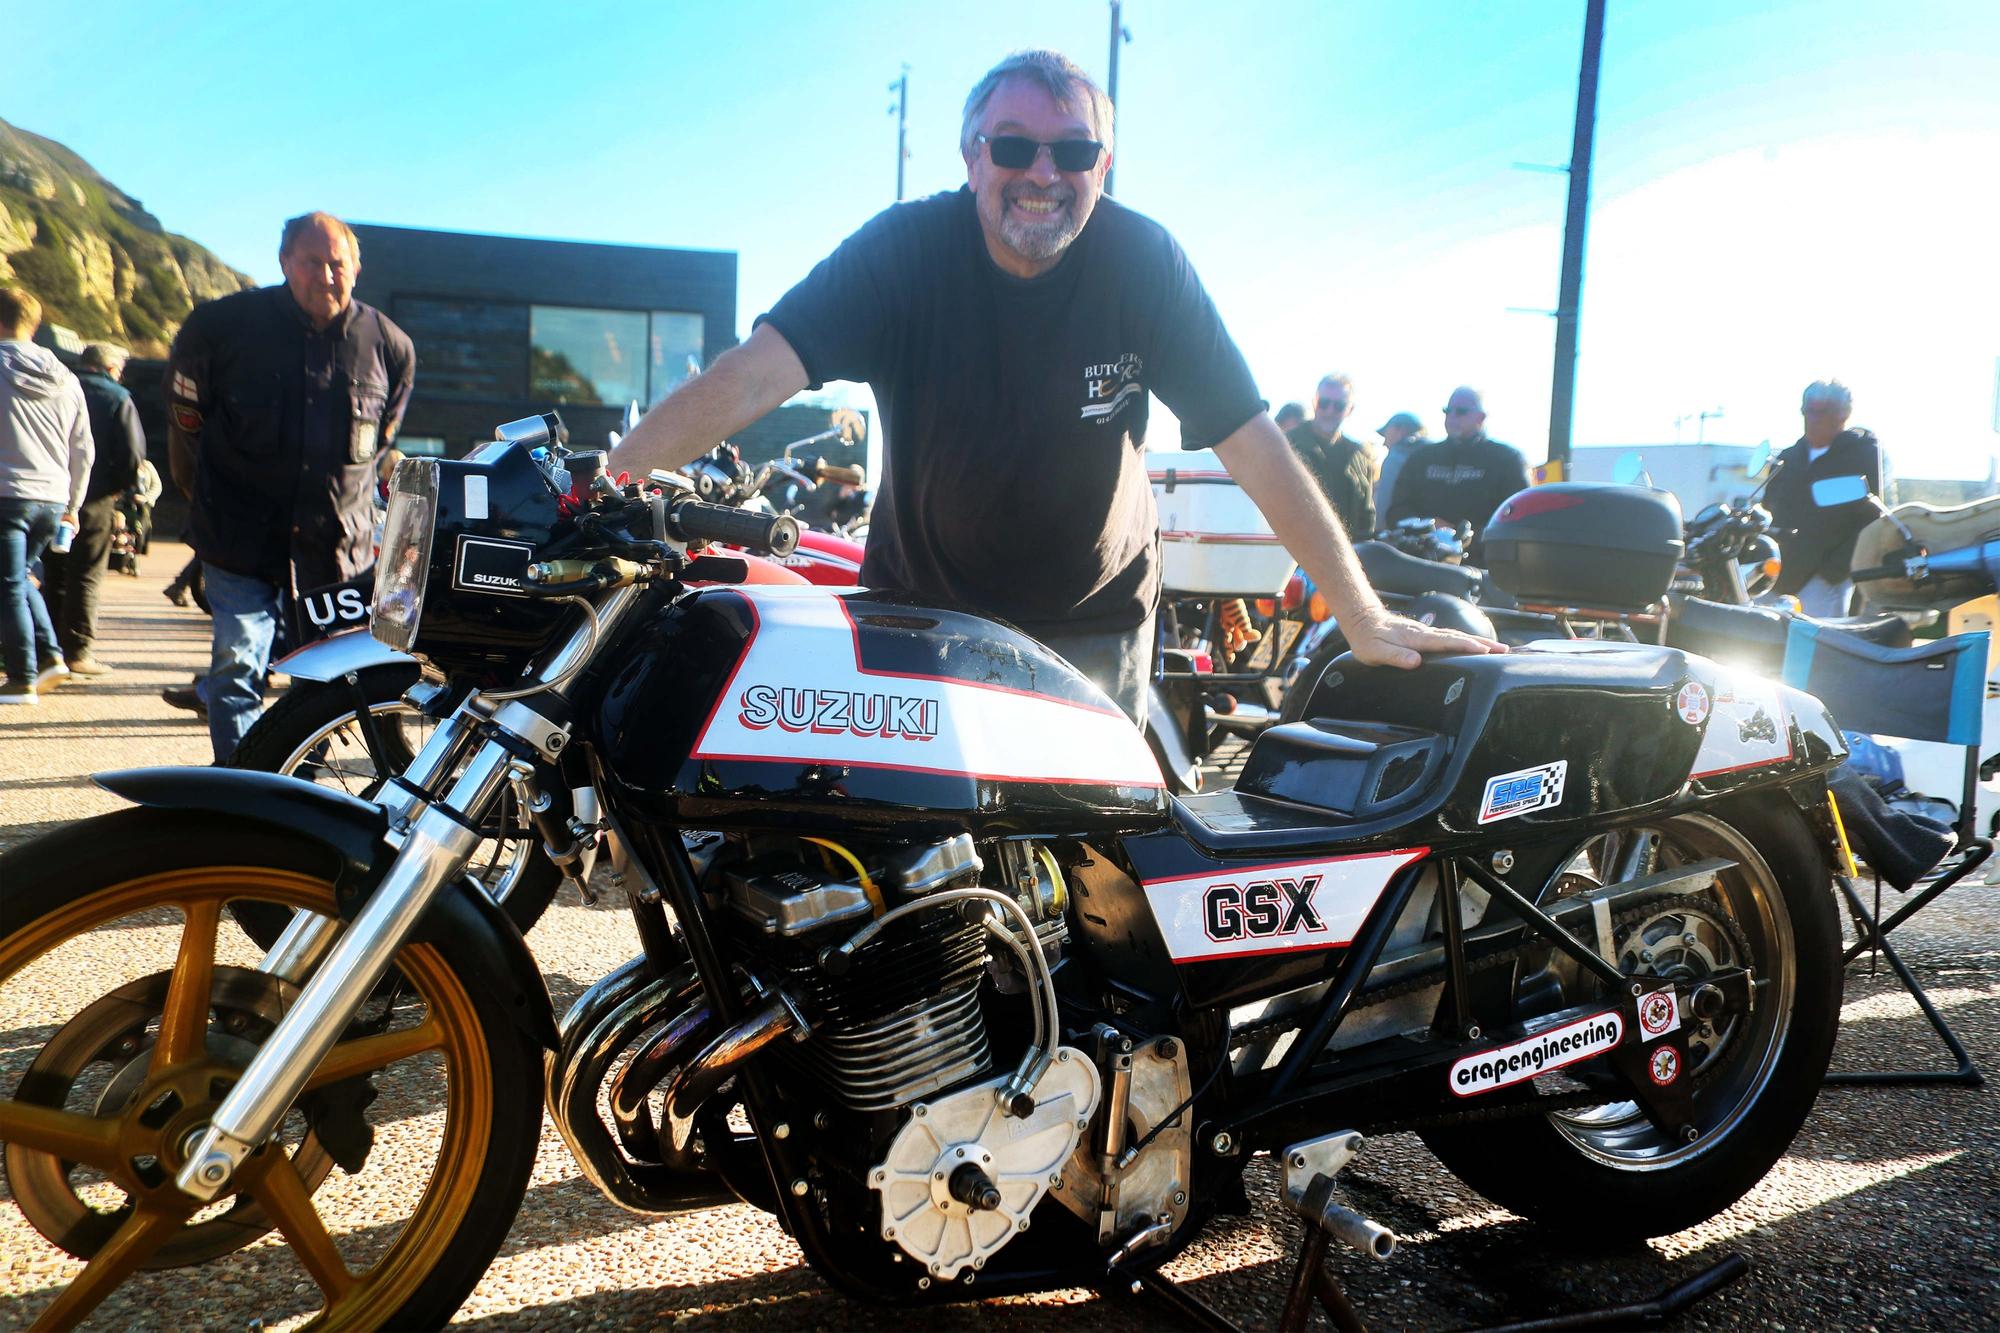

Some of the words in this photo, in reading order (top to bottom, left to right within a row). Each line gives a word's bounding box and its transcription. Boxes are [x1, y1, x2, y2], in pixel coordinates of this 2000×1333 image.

[1084, 352, 1143, 378] BUTCERS
[473, 573, 521, 587] SUZUK
[304, 588, 372, 625] US
[738, 684, 938, 742] SUZUKI
[1489, 801, 1521, 814] PERFORMANCE
[1522, 797, 1539, 806] SPARES
[1491, 774, 1543, 808] SPS
[1202, 874, 1328, 943] GSX
[1457, 1021, 1617, 1086] crapengineering
